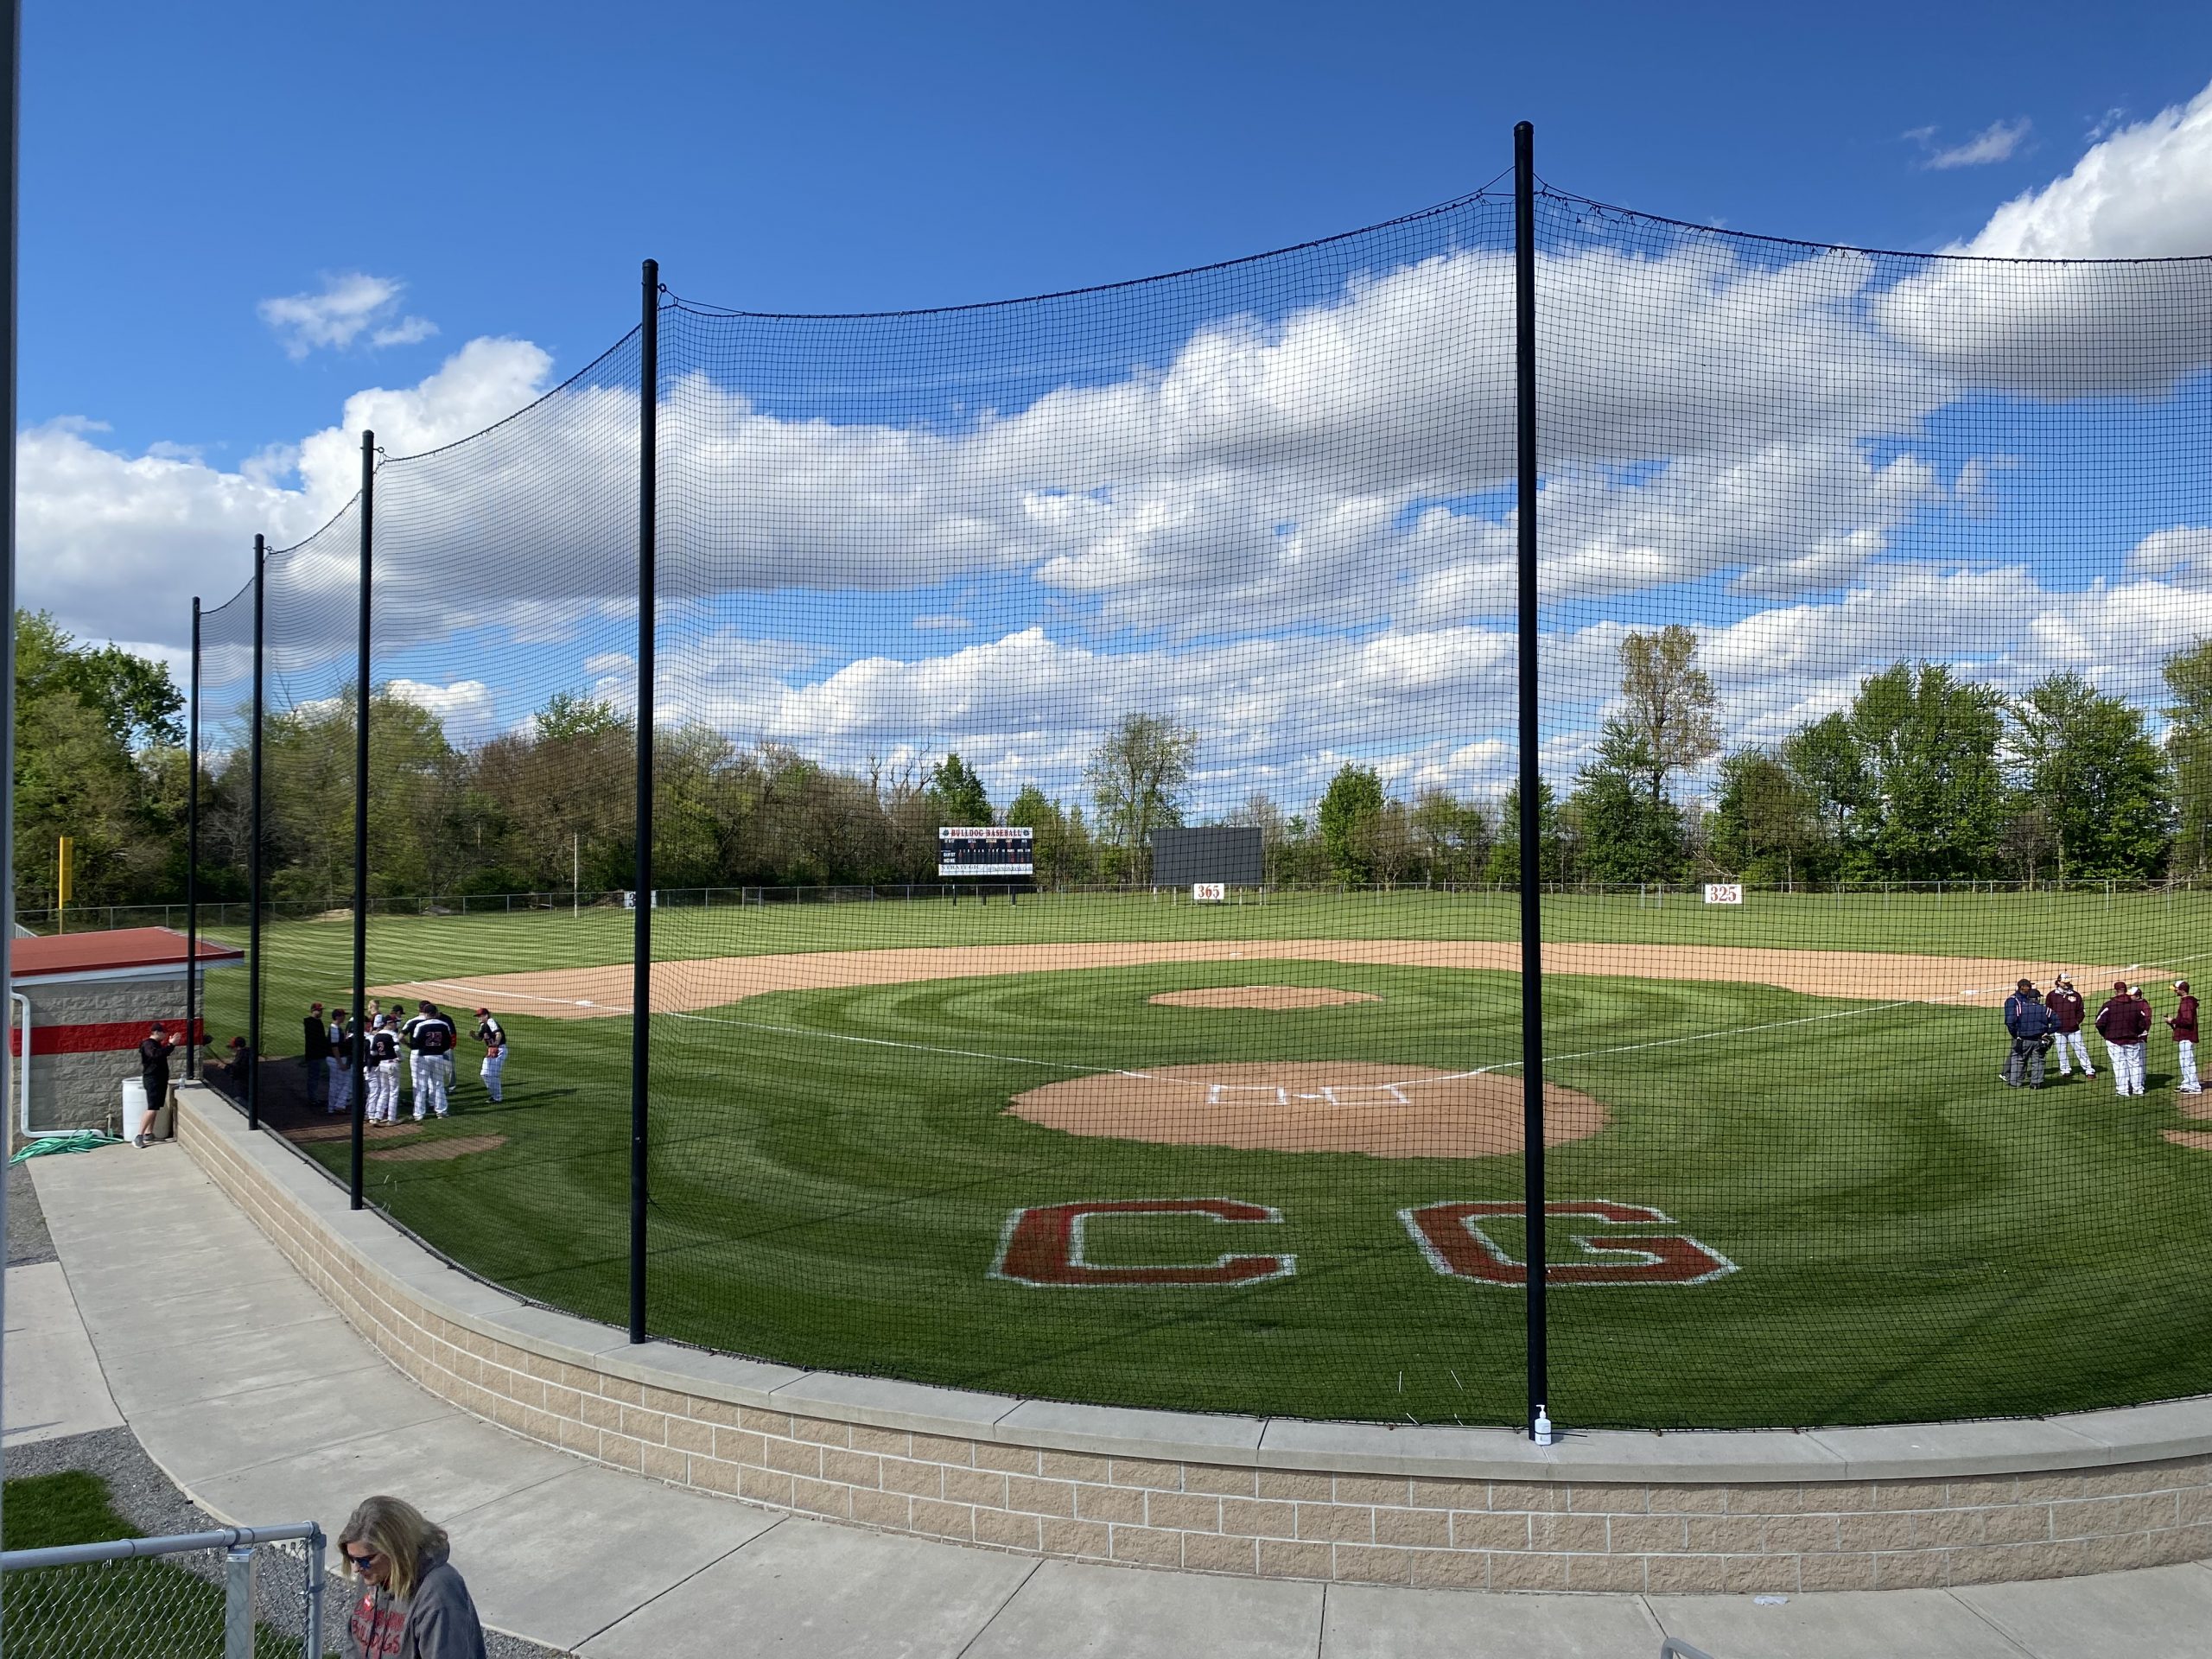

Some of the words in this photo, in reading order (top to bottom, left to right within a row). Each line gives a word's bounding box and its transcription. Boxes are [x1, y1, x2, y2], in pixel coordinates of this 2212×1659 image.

[1198, 885, 1220, 898] 365
[1711, 886, 1737, 901] 325
[987, 1198, 1298, 1288] C
[1396, 1198, 1741, 1288] G
[352, 1619, 400, 1654] BULLDGS
